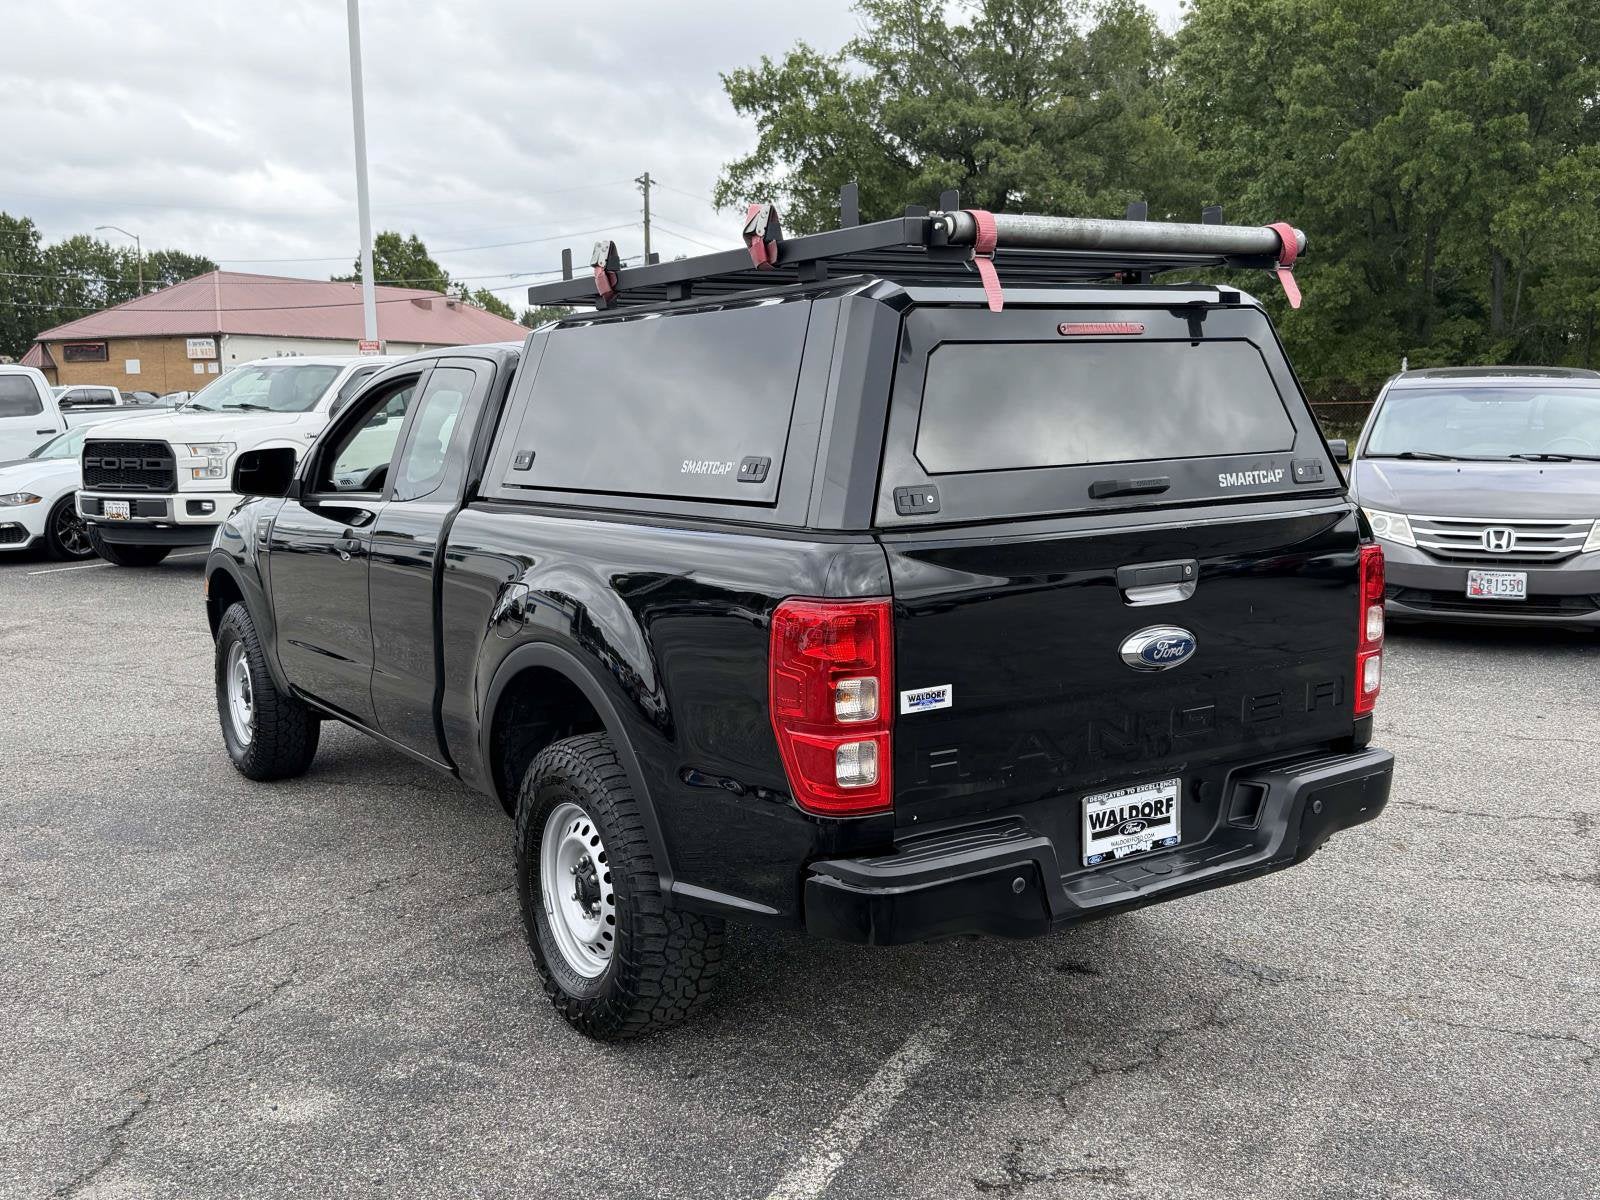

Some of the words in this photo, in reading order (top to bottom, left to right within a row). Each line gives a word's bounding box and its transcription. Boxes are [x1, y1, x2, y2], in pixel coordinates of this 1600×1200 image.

[84, 457, 165, 470] FORD
[680, 460, 733, 475] SMARTCAP
[1218, 469, 1283, 487] SMARTCAP
[1153, 639, 1185, 660] Ford
[907, 690, 947, 703] WALDORF
[1089, 790, 1125, 803] DEDICATED
[1127, 787, 1136, 796] TO
[1136, 779, 1177, 793] EXCELLENCE
[1088, 797, 1174, 830] WALDORF
[1123, 821, 1142, 835] Ford
